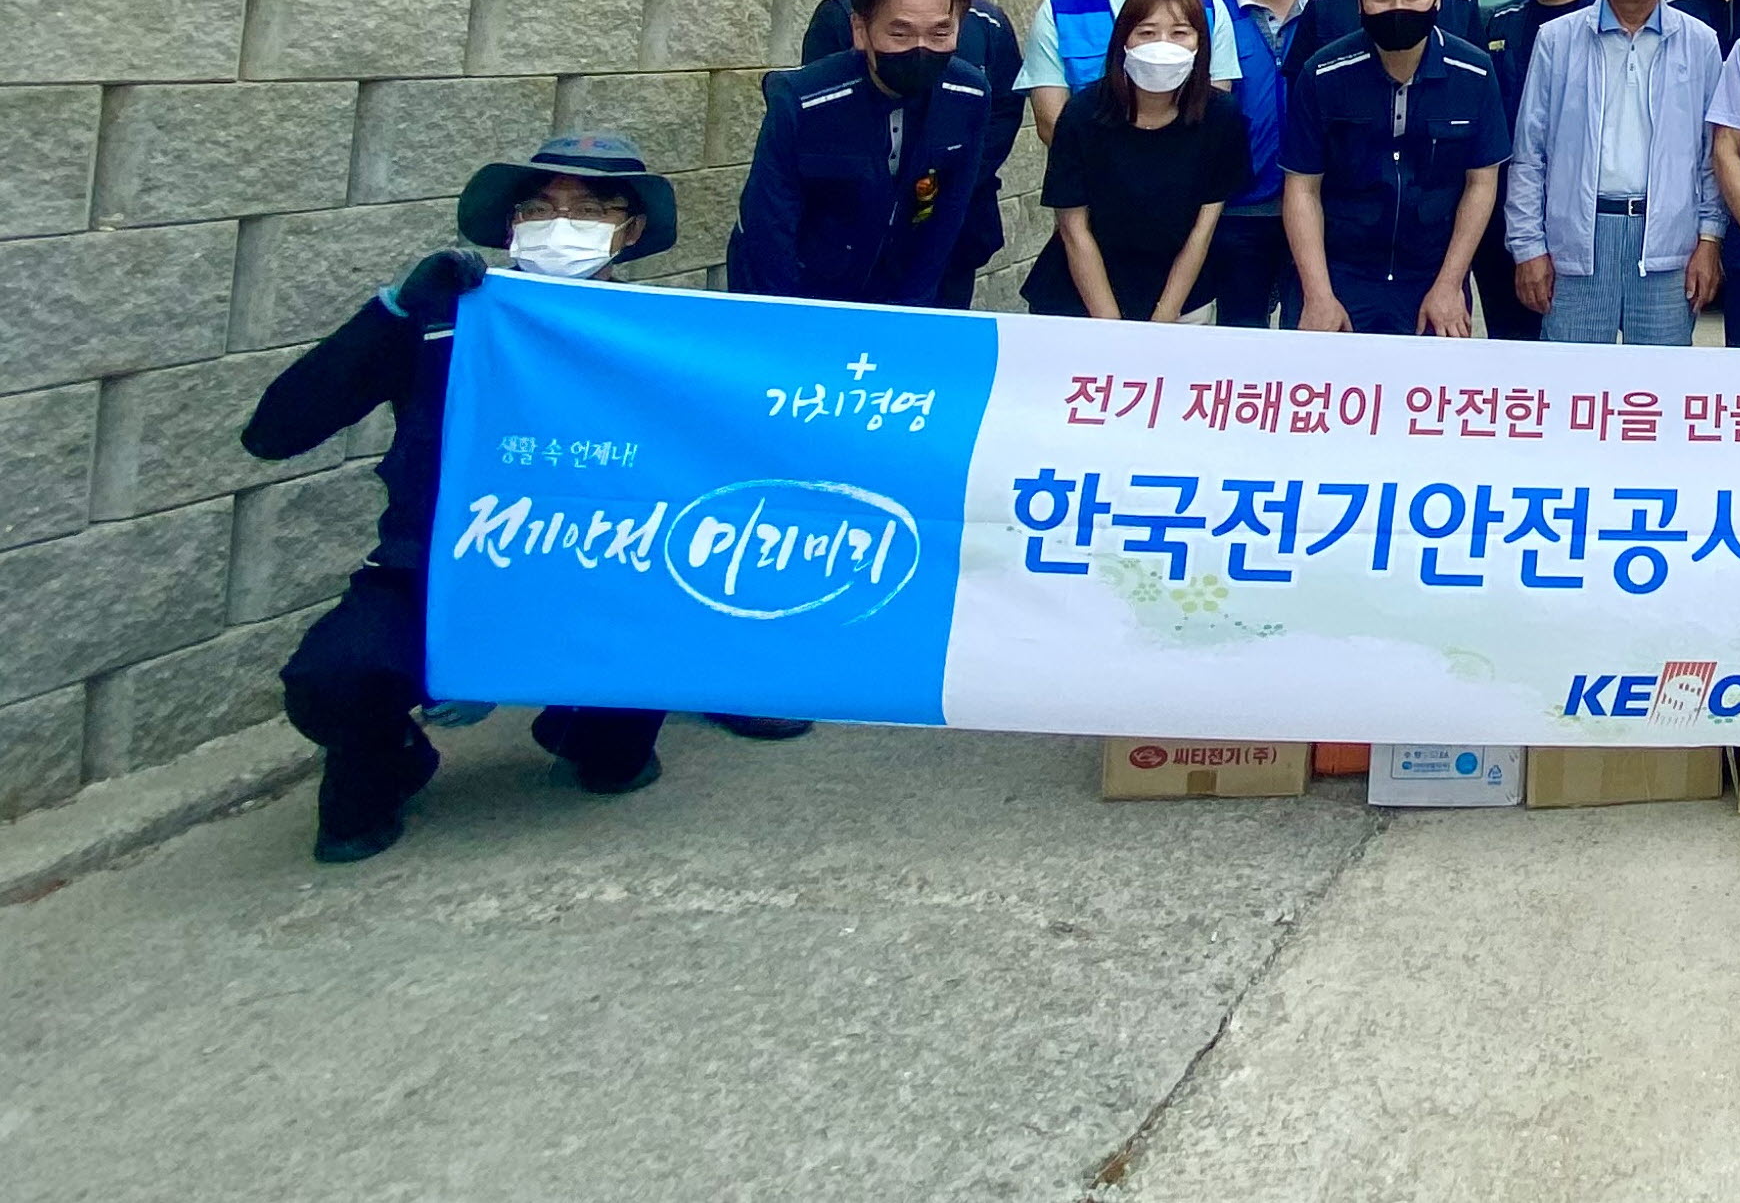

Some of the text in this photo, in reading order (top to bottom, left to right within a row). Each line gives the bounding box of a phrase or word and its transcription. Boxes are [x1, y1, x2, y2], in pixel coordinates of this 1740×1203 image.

[766, 386, 936, 431] 가치경영
[1065, 374, 1164, 429] 전기
[1182, 379, 1383, 437] 재해없이
[1405, 384, 1551, 440] 안전한
[1569, 390, 1663, 443] 마을
[497, 436, 639, 468] 생활 속 언제나!
[453, 494, 896, 596] 전기안전 미리미리
